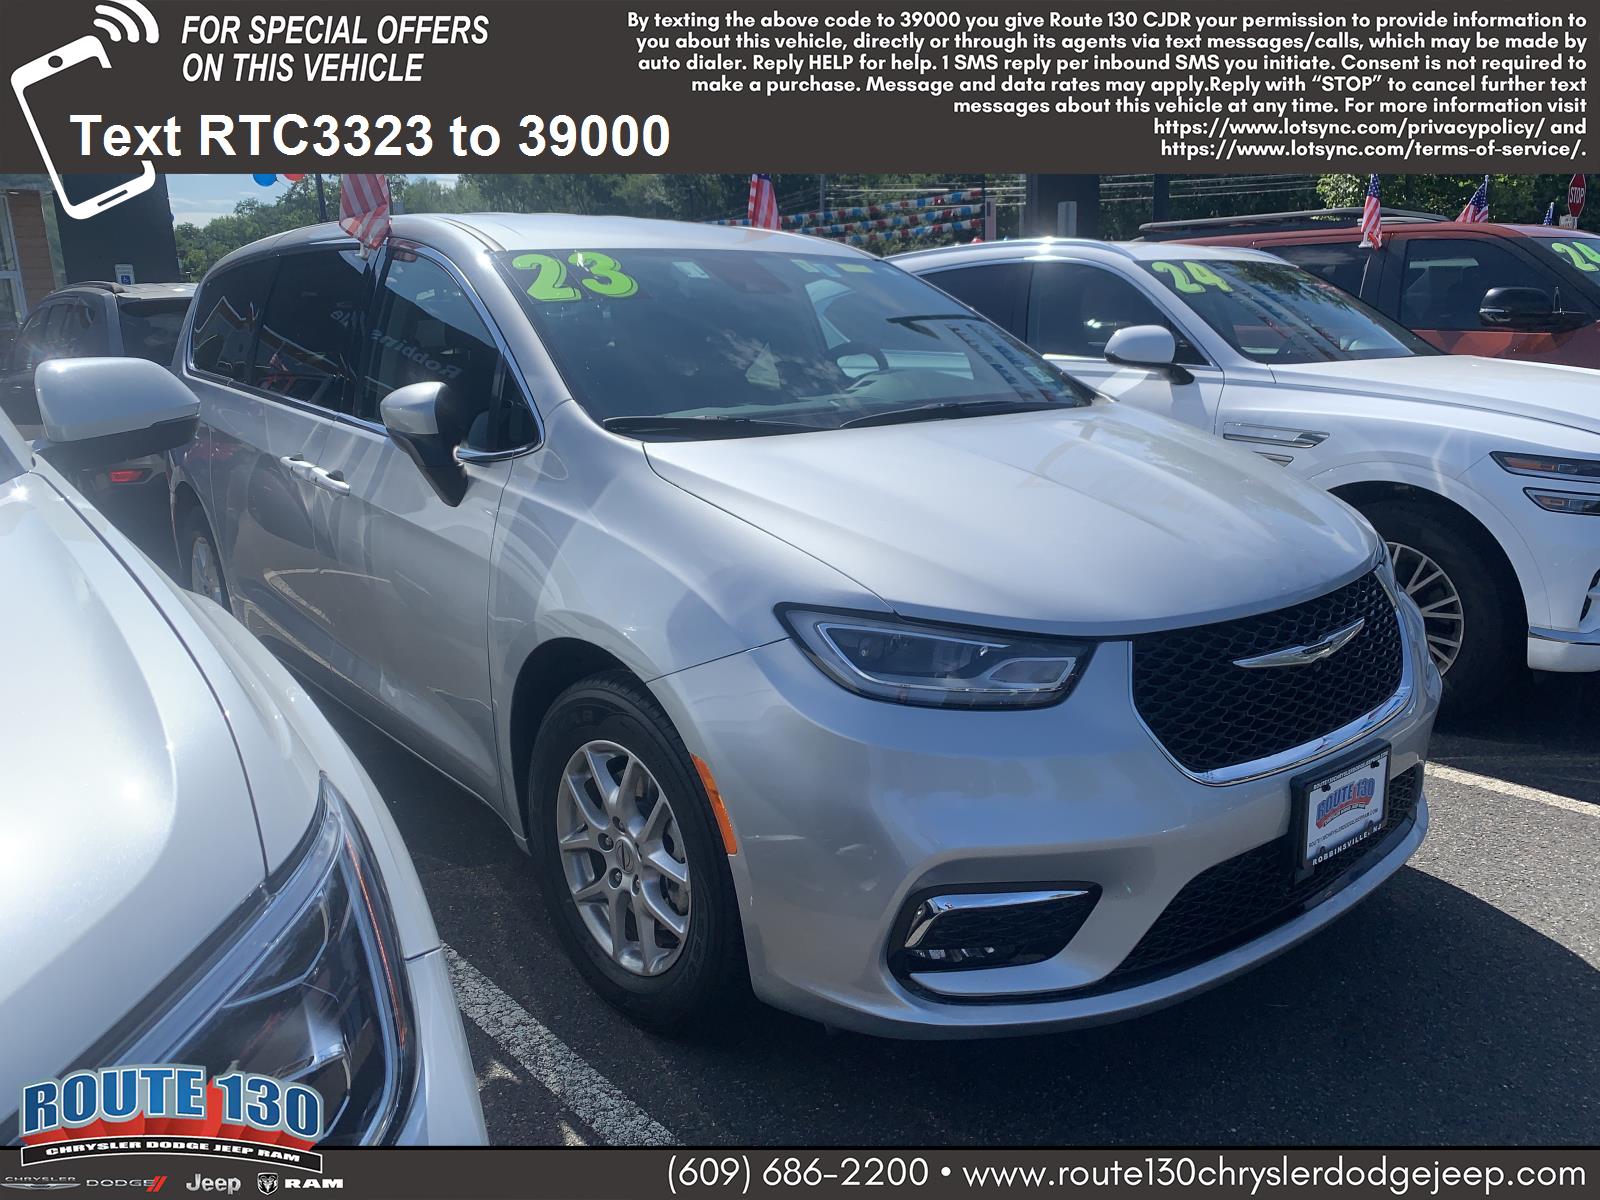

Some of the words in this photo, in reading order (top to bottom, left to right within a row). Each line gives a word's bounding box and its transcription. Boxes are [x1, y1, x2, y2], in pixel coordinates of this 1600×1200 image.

[1569, 187, 1585, 204] STOP
[511, 251, 639, 302] 23
[1151, 261, 1234, 293] 24
[1316, 782, 1357, 820] ROUTE
[1357, 777, 1376, 799] 130
